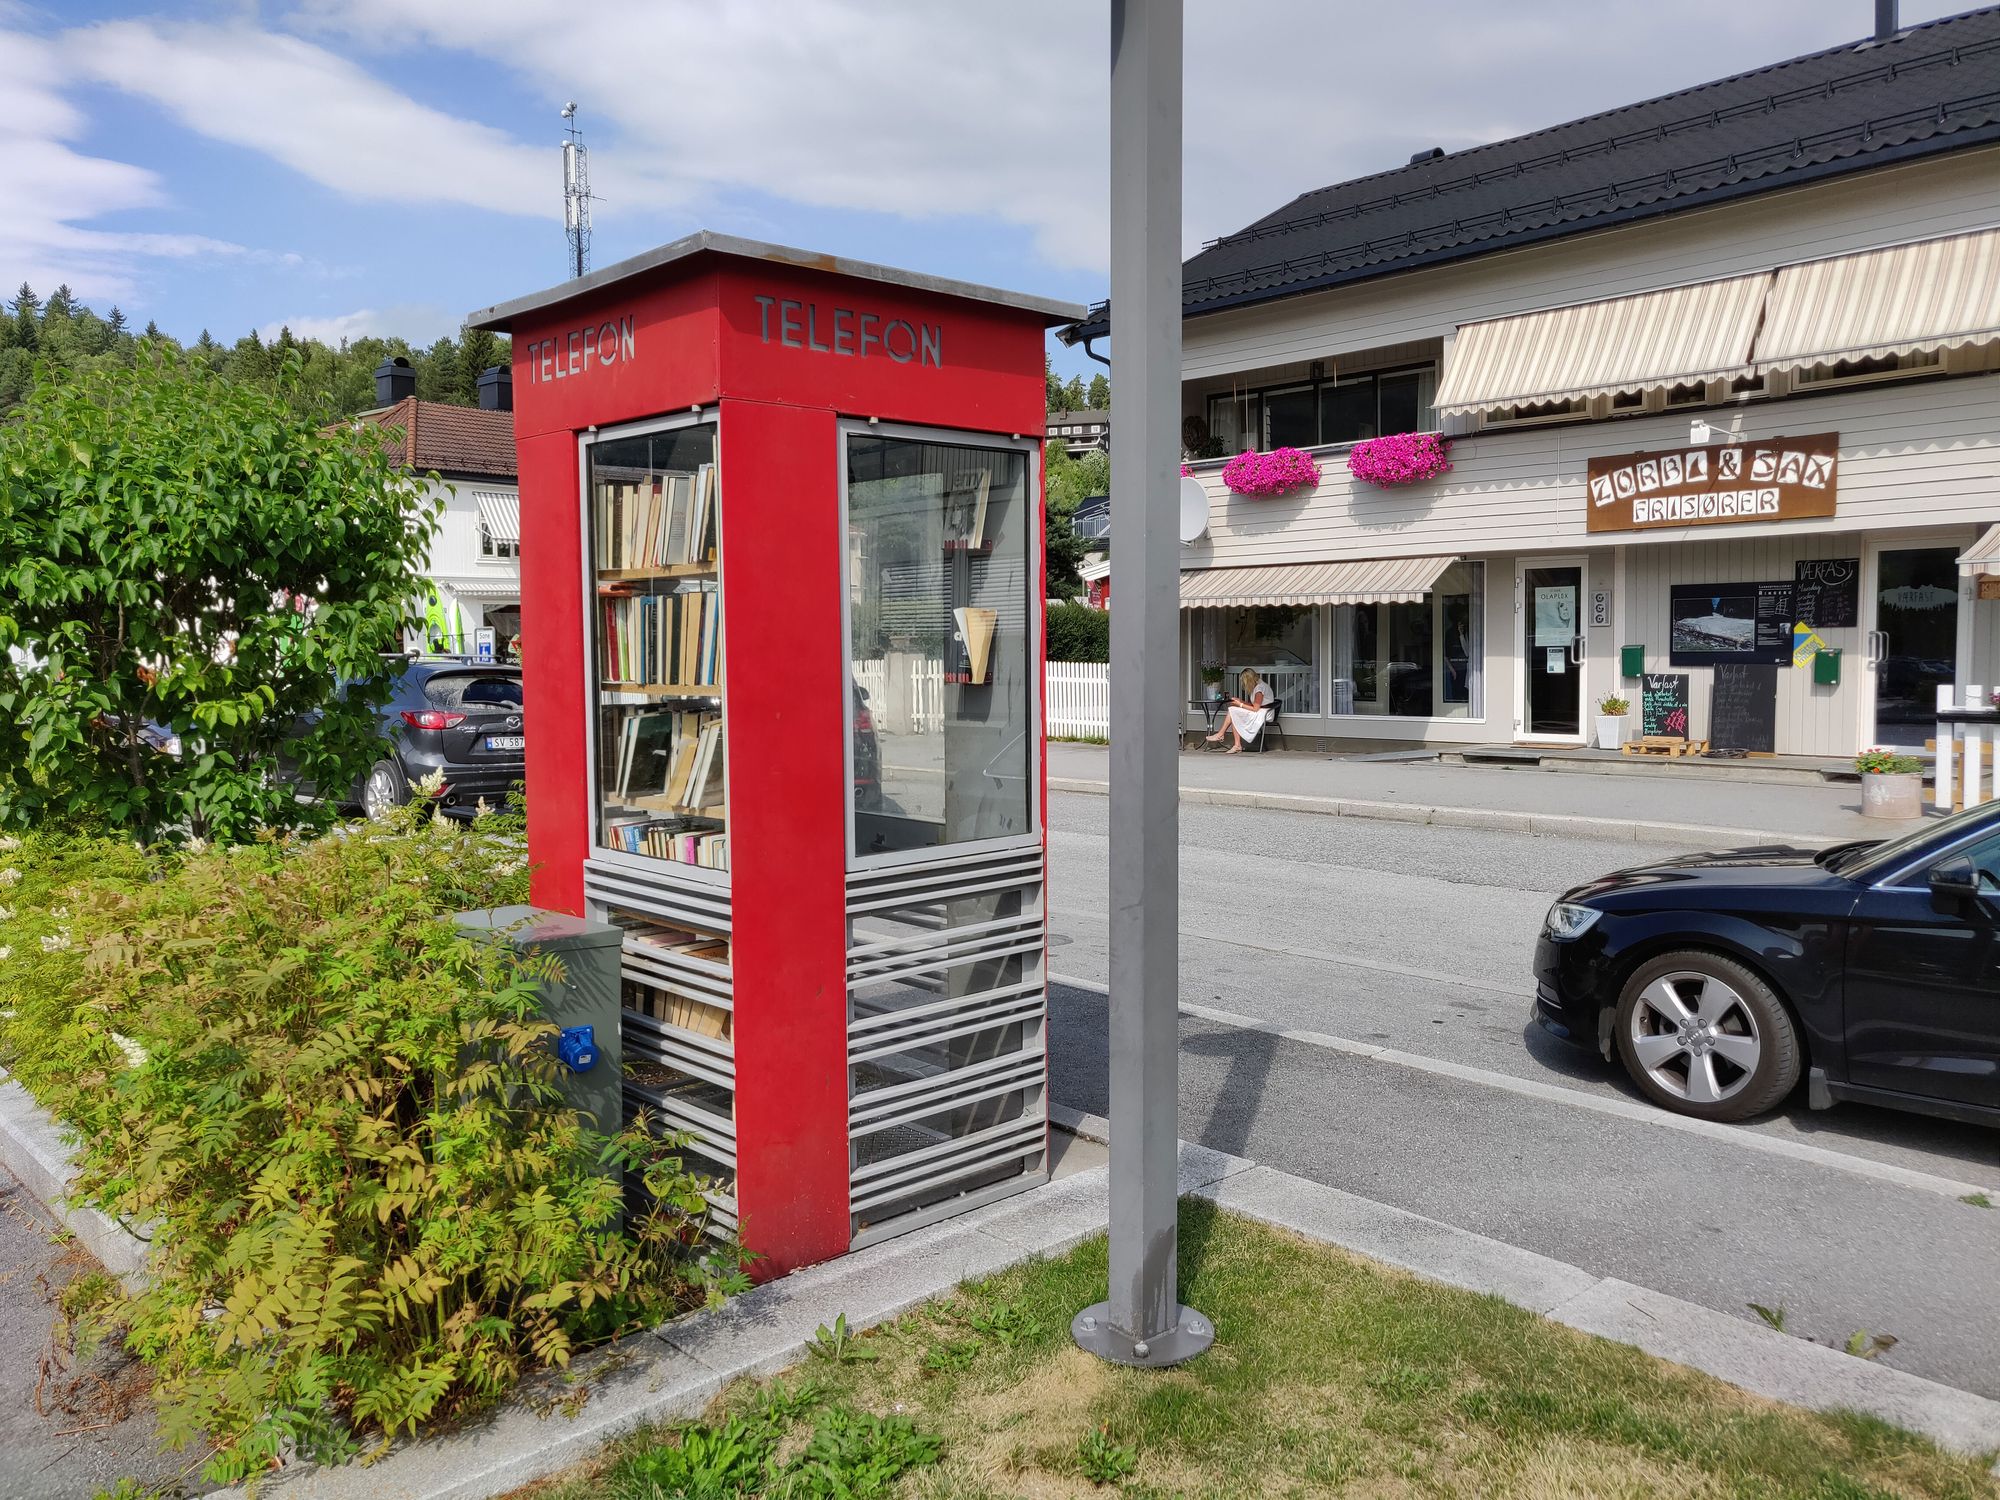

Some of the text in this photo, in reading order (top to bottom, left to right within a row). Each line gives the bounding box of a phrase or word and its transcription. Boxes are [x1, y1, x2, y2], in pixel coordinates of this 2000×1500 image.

[755, 295, 943, 369] TELEFON
[527, 314, 636, 385] TELEFON
[1591, 449, 1834, 506] ZORBA & SAX
[1633, 488, 1779, 522] FRISØRER
[1797, 560, 1859, 581] VÆRFAST
[479, 632, 490, 640] Sone
[494, 737, 524, 747] SV 587
